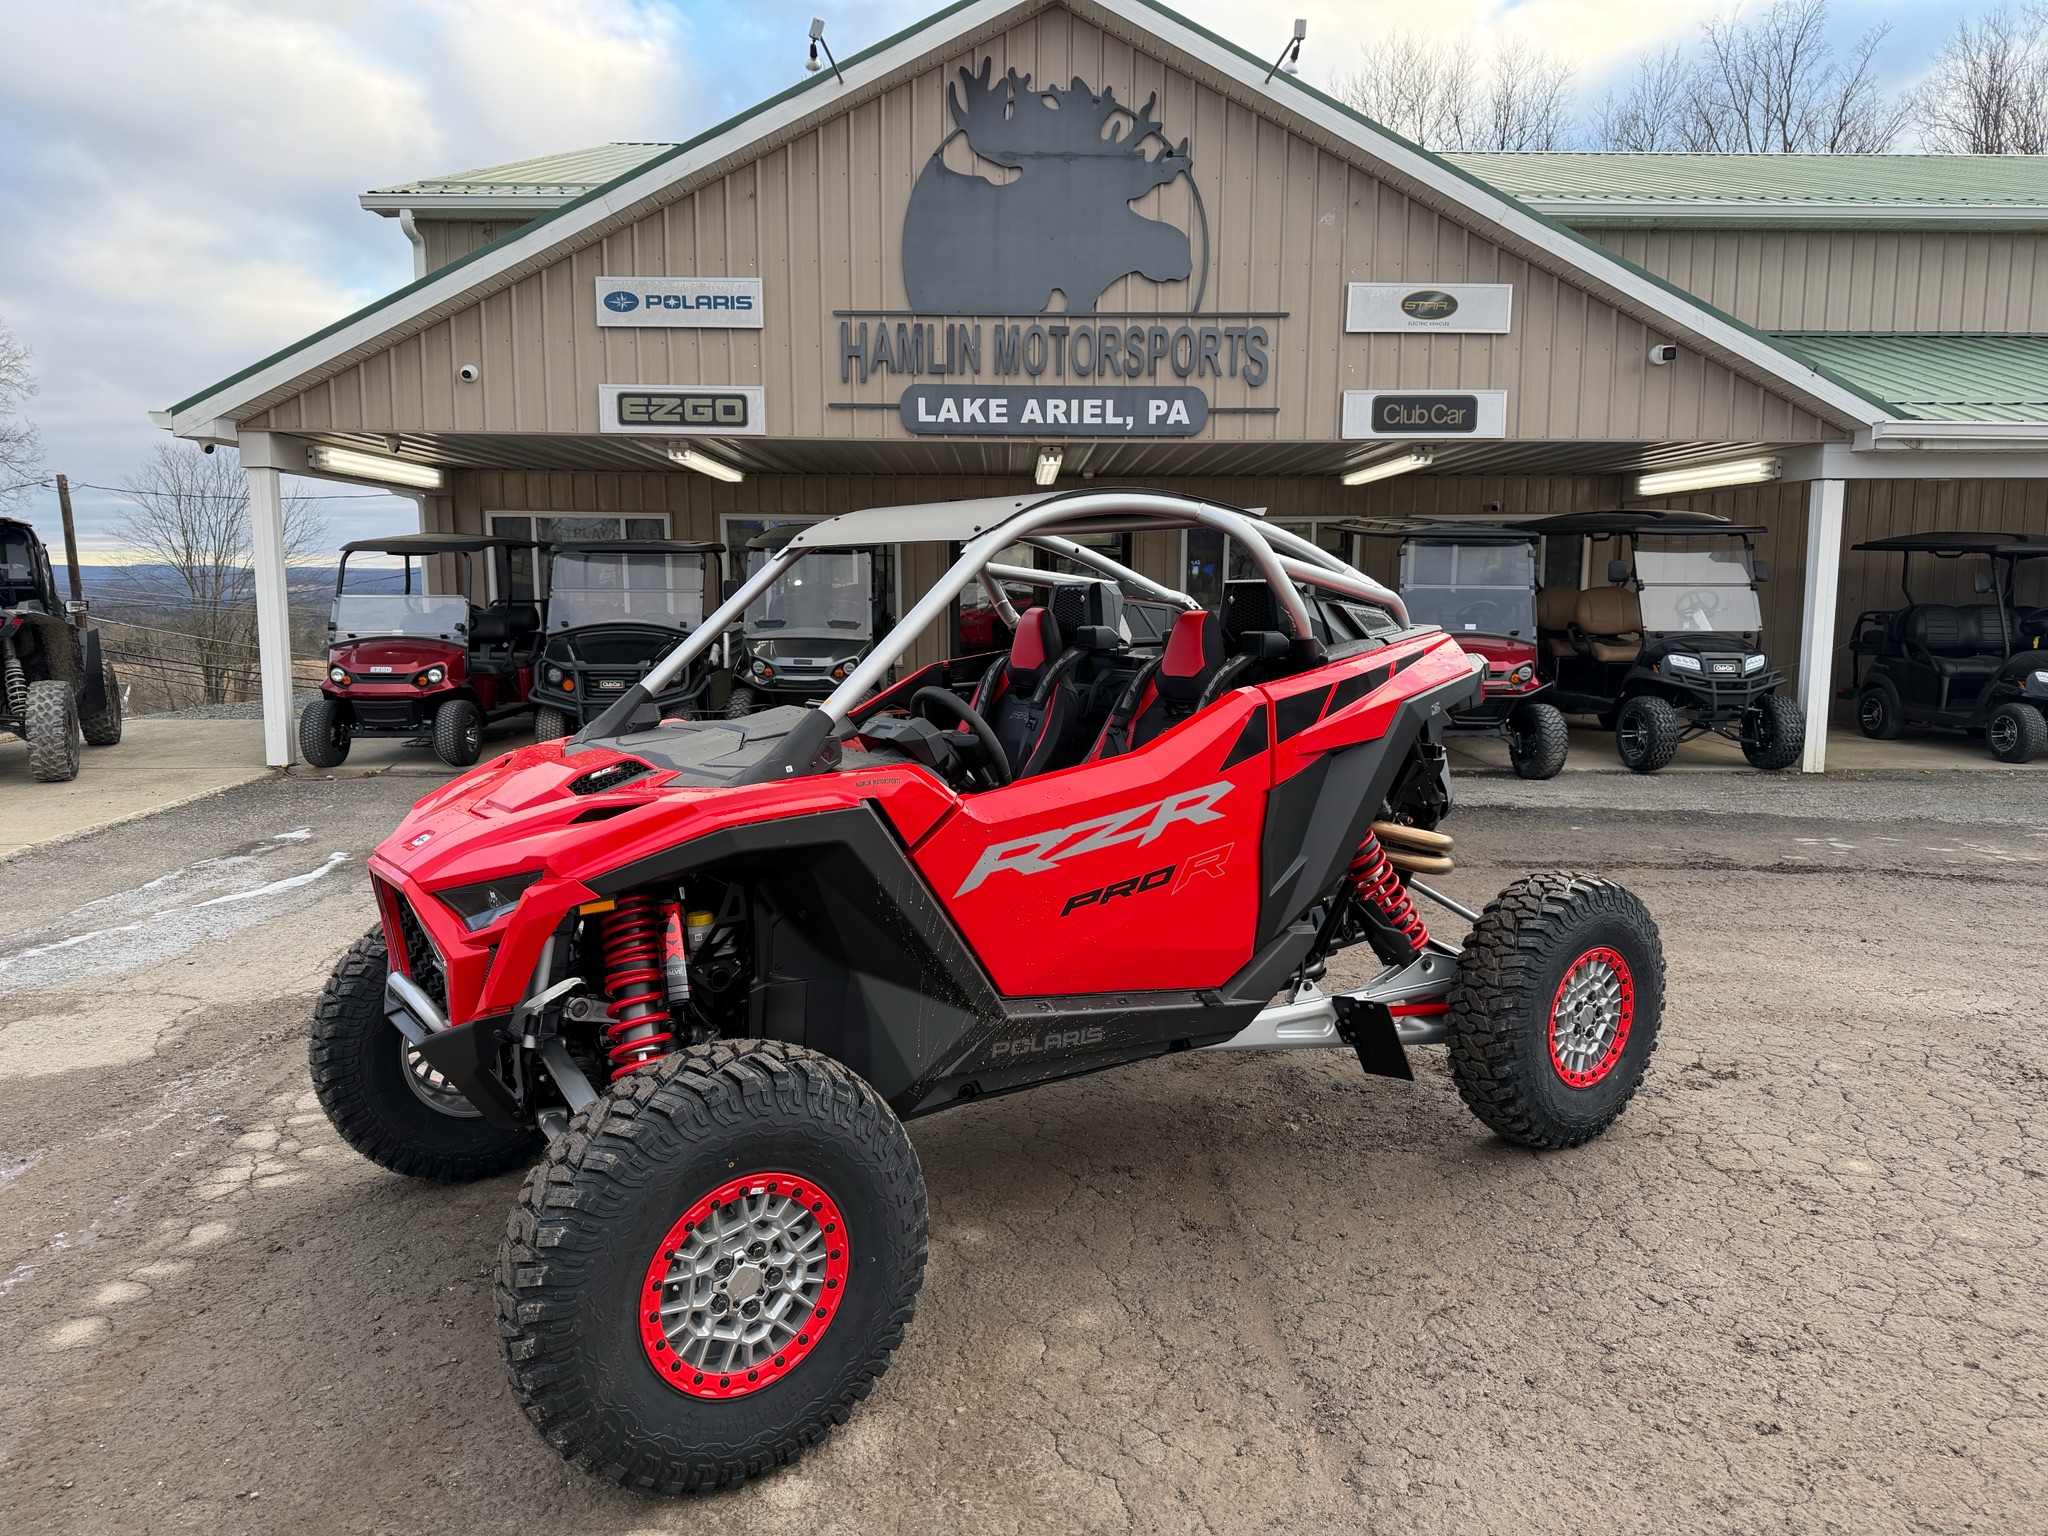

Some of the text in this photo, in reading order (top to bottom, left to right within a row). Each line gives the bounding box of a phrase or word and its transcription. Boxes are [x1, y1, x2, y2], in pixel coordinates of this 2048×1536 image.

[645, 295, 753, 310] POLARIS
[1404, 301, 1448, 310] STAR
[840, 321, 1269, 386] HAMLIN MOTORSPORTS
[622, 397, 745, 424] EZGO
[917, 397, 1190, 431] LAKE ARIEL, PA
[1383, 404, 1466, 424] Club Car
[952, 780, 1236, 899] RZR
[1059, 841, 1235, 918] PRO R
[991, 1027, 1103, 1059] POLARIS
